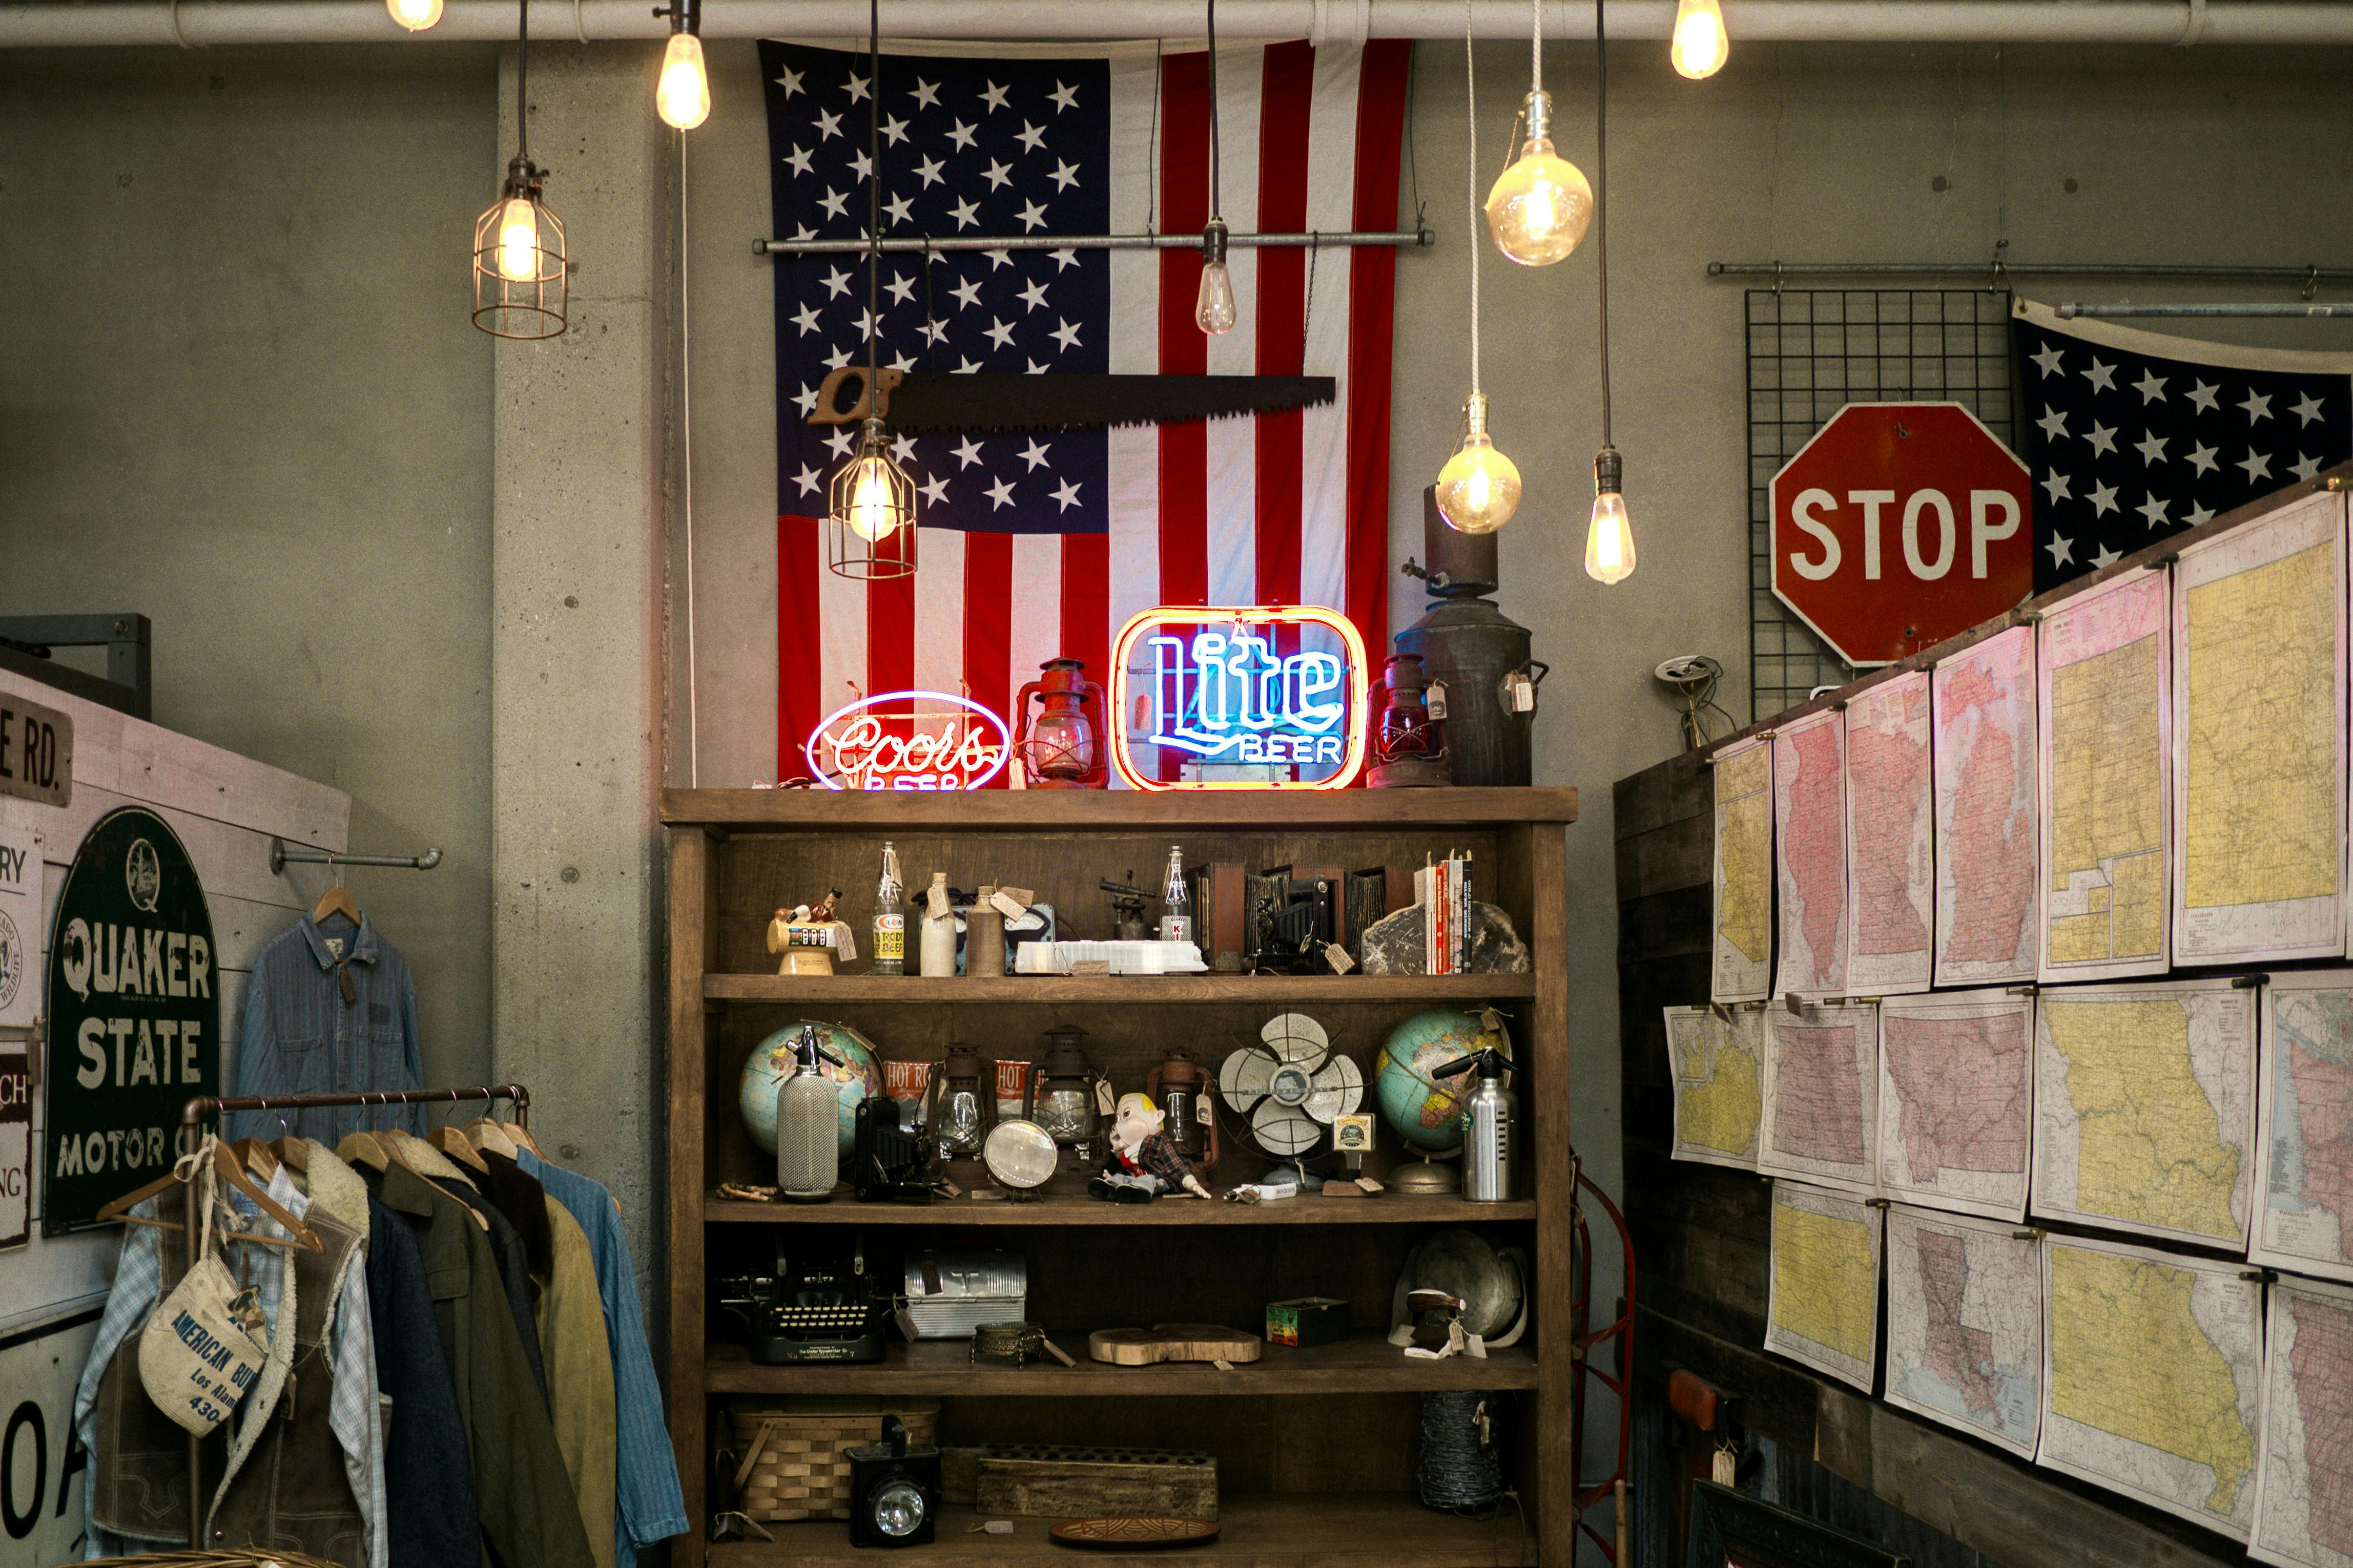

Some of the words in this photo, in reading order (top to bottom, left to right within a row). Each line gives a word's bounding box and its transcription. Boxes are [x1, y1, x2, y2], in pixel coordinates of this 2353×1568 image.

[1790, 488, 2020, 580] STOP
[1148, 633, 1344, 756] Lite
[24, 717, 59, 790] RD.
[822, 718, 999, 774] Coors
[1239, 733, 1341, 764] BEER
[63, 917, 210, 1002] QUAKER
[77, 1017, 201, 1089] STATE
[888, 1065, 910, 1087] HOT
[998, 1065, 1021, 1088] HOT
[57, 1127, 164, 1178] MOTOR
[171, 1309, 234, 1372] AMERICAN
[190, 1367, 211, 1389] Los
[189, 1396, 221, 1424] 430-
